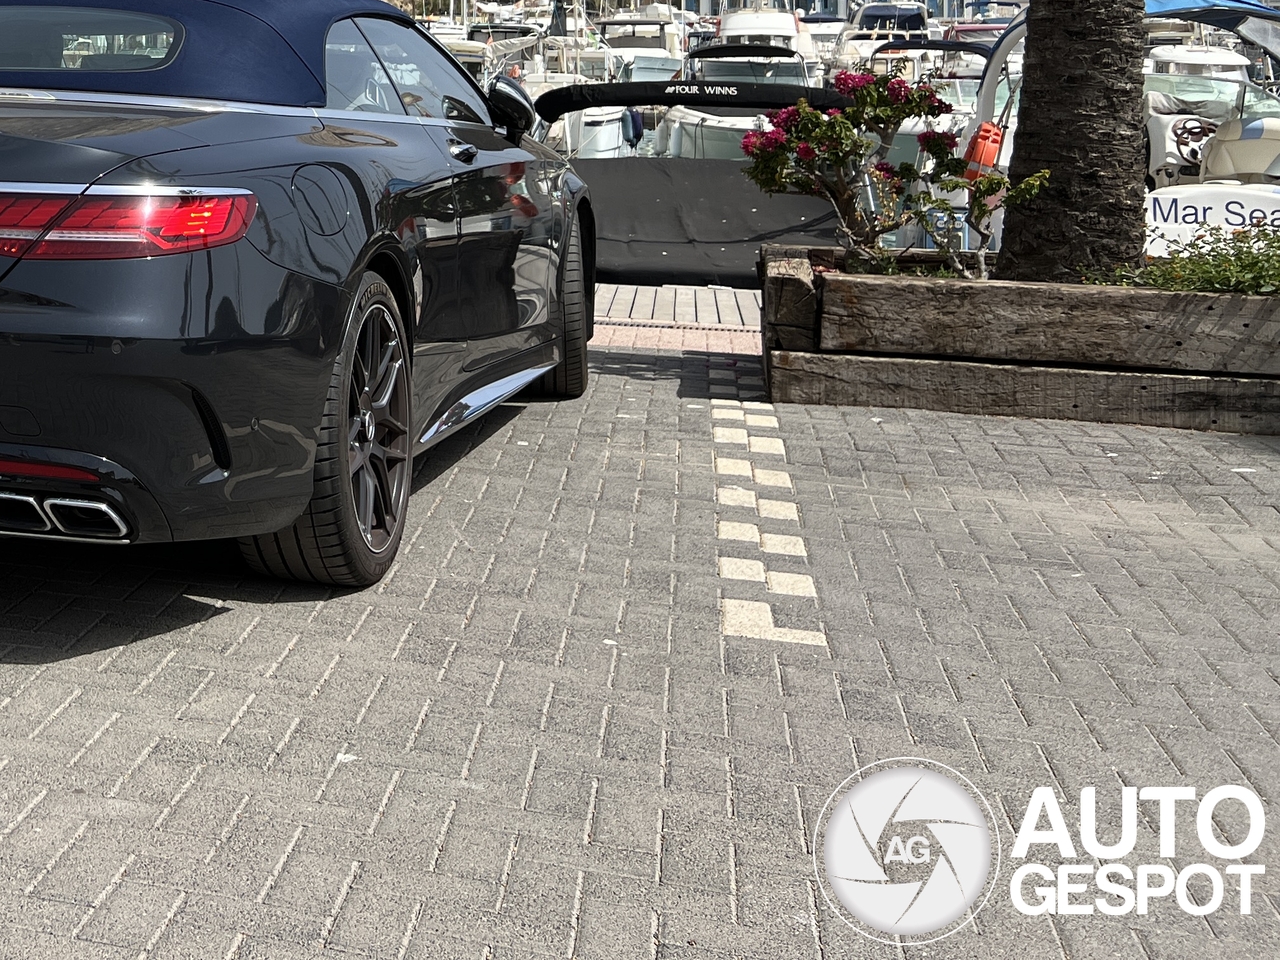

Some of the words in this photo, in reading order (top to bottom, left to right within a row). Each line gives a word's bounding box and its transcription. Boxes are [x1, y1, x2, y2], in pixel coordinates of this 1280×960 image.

[675, 85, 700, 94] FOUR
[704, 85, 738, 95] WINNS
[1152, 197, 1213, 224] Mar
